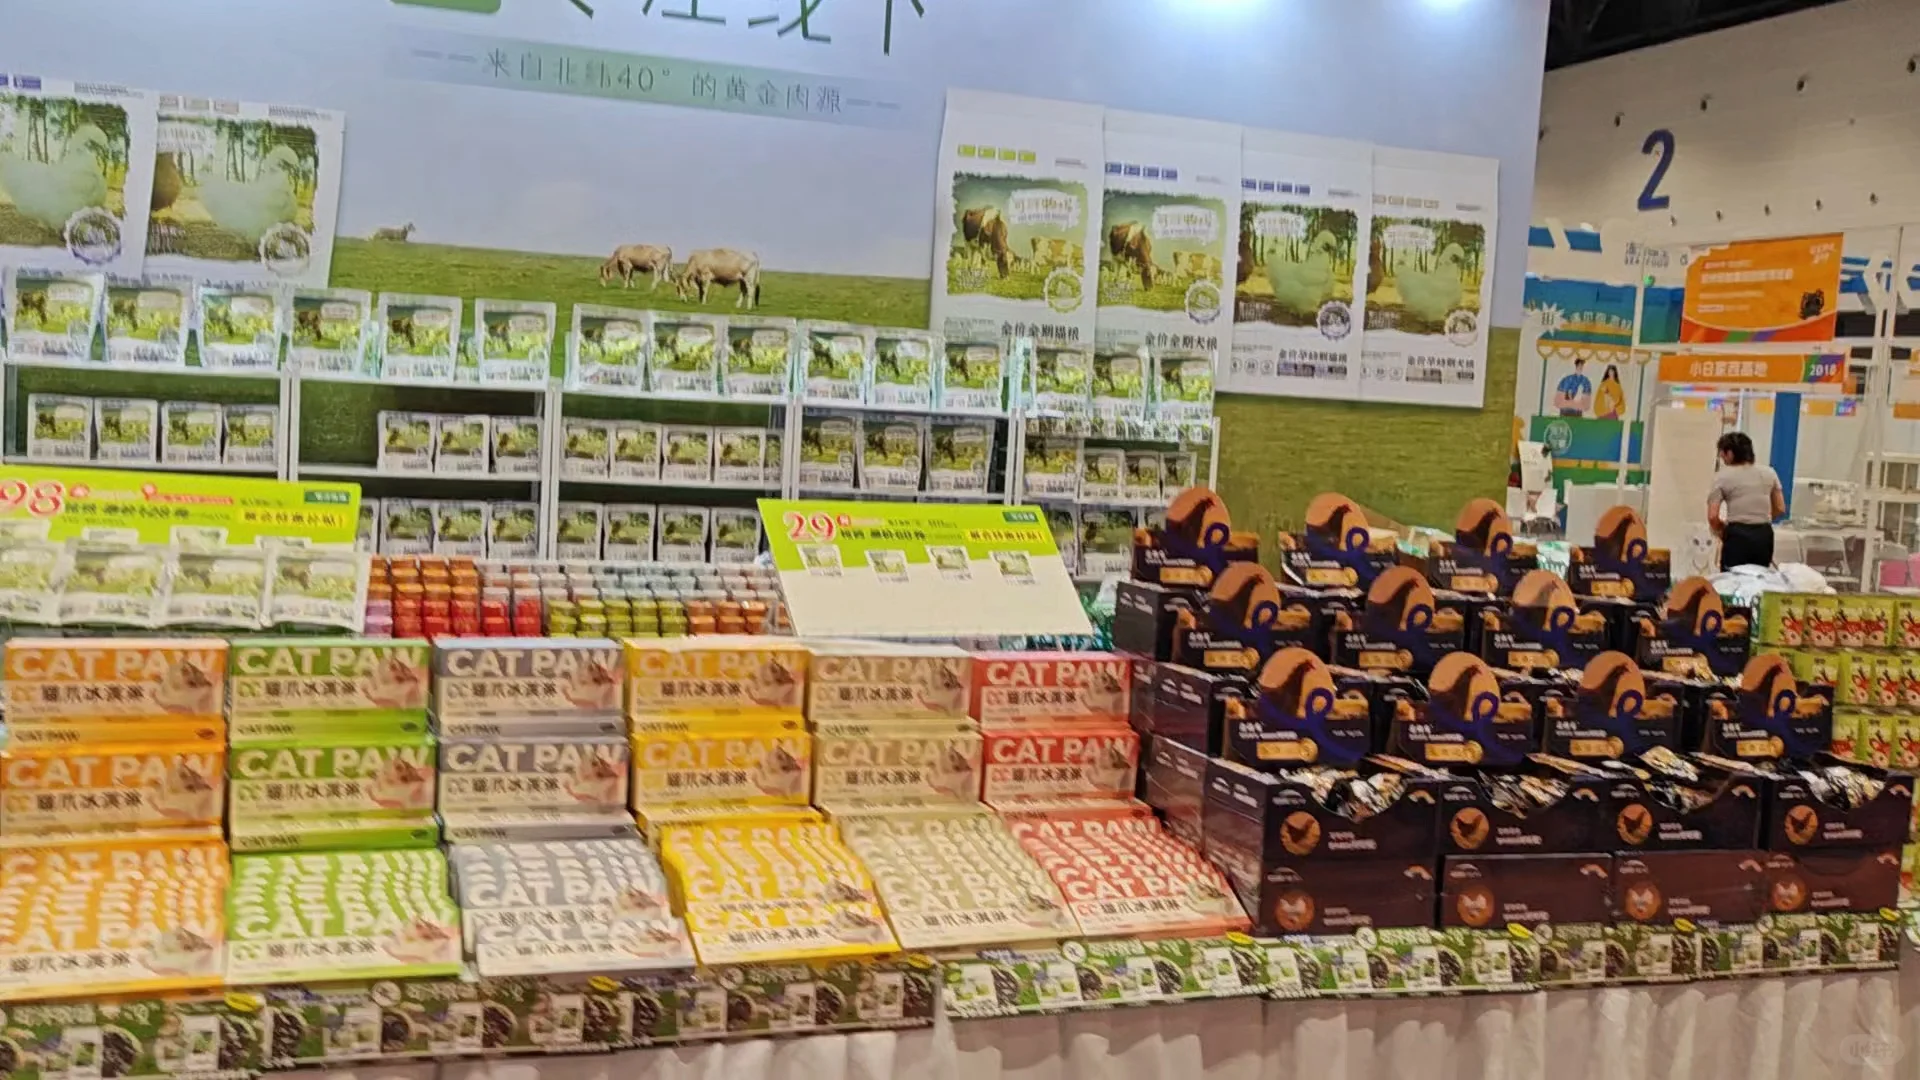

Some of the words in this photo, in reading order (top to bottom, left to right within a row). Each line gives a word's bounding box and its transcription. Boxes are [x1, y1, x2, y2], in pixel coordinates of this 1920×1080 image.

[1638, 129, 1675, 211] 2
[784, 511, 836, 542] 29
[11, 648, 107, 679] CAT
[114, 648, 218, 680] PAW
[237, 647, 322, 676] CAT
[330, 647, 424, 676] PAW
[447, 649, 525, 677] CAT
[532, 648, 620, 677] PAW
[639, 650, 713, 676] CAT
[719, 650, 799, 676] PAW
[817, 658, 885, 681] CAT
[892, 658, 966, 681] PAW
[986, 662, 1050, 687] CAT
[1056, 661, 1126, 687] PAW
[237, 749, 323, 779] CAT
[333, 748, 429, 779] PAW
[448, 744, 529, 773] CAT
[535, 741, 624, 772] PAW
[643, 740, 717, 769] CAT
[724, 738, 809, 769] PAW
[826, 740, 893, 766] CAT
[901, 738, 978, 765] PAW
[993, 739, 1060, 764] CAT
[1067, 737, 1135, 764] PAW
[6, 755, 107, 789] CAT
[111, 754, 216, 788] PAW
[1066, 878, 1136, 901] CAT
